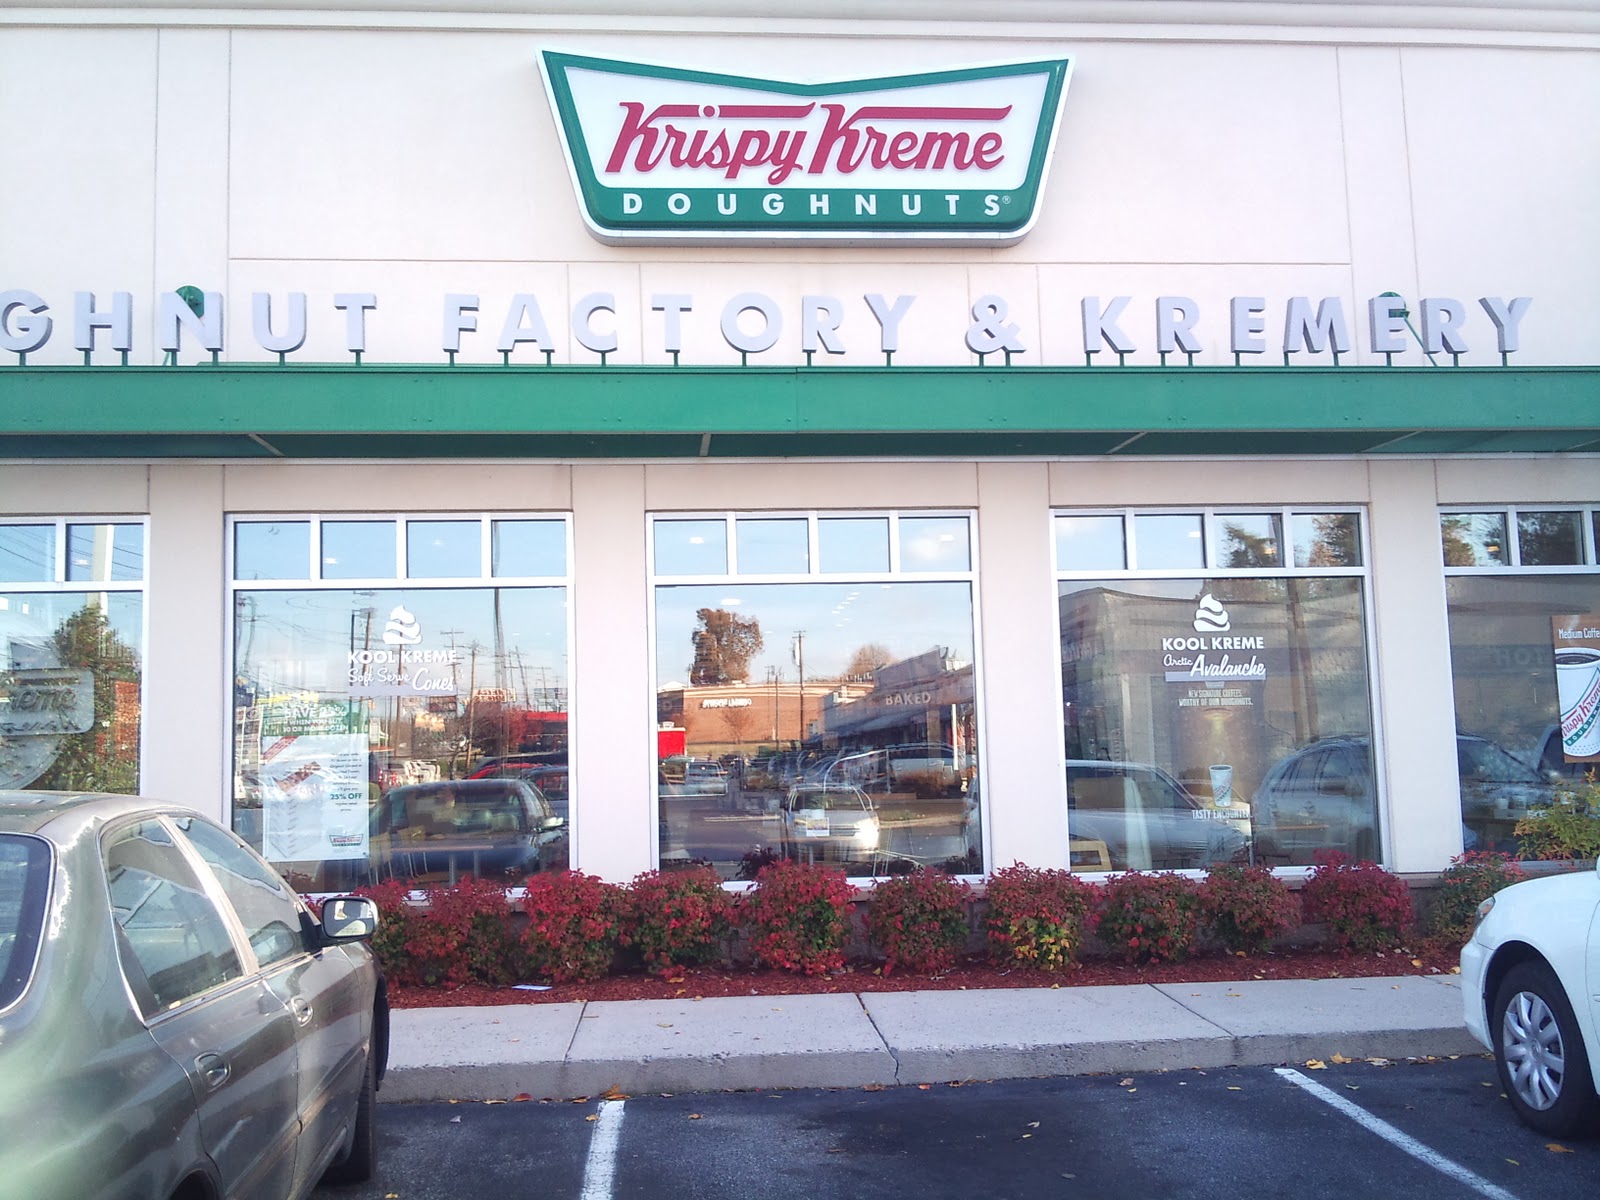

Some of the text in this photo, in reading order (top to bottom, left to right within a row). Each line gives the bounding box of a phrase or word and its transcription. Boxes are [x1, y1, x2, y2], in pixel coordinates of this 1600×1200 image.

[605, 101, 1013, 185] Krispy Kreme
[0, 288, 1534, 355] GHNUT FACTORY & KREMERY
[1558, 627, 1583, 639] Medium
[1162, 636, 1265, 651] KOOL KREME
[347, 649, 458, 664] KOOL KREME
[1163, 653, 1267, 677] Arctic Avalanche
[347, 666, 455, 692] Soft Serve Cones
[885, 691, 932, 706] BAKED
[284, 705, 316, 718] SAVE
[347, 792, 363, 800] OFF
[1191, 809, 1211, 820] TASTY
